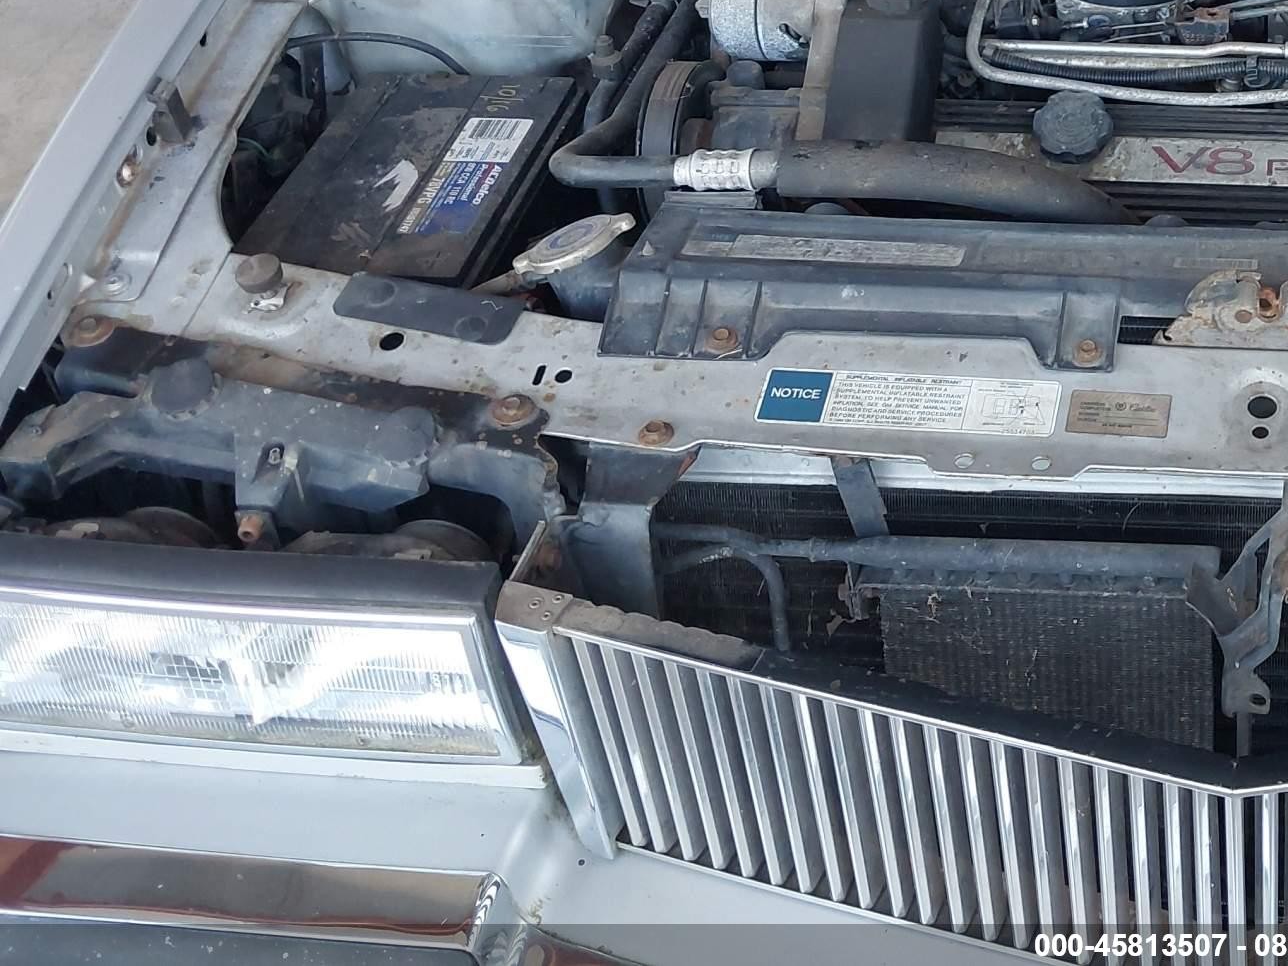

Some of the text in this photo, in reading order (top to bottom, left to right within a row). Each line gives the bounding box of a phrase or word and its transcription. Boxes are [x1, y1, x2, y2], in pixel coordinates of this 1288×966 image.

[1152, 146, 1254, 175] V8
[456, 172, 472, 184] CCA
[461, 163, 488, 202] Professional
[472, 164, 503, 205] ACDelco
[771, 387, 822, 400] NOTICE
[929, 392, 965, 400] RESTRAINT
